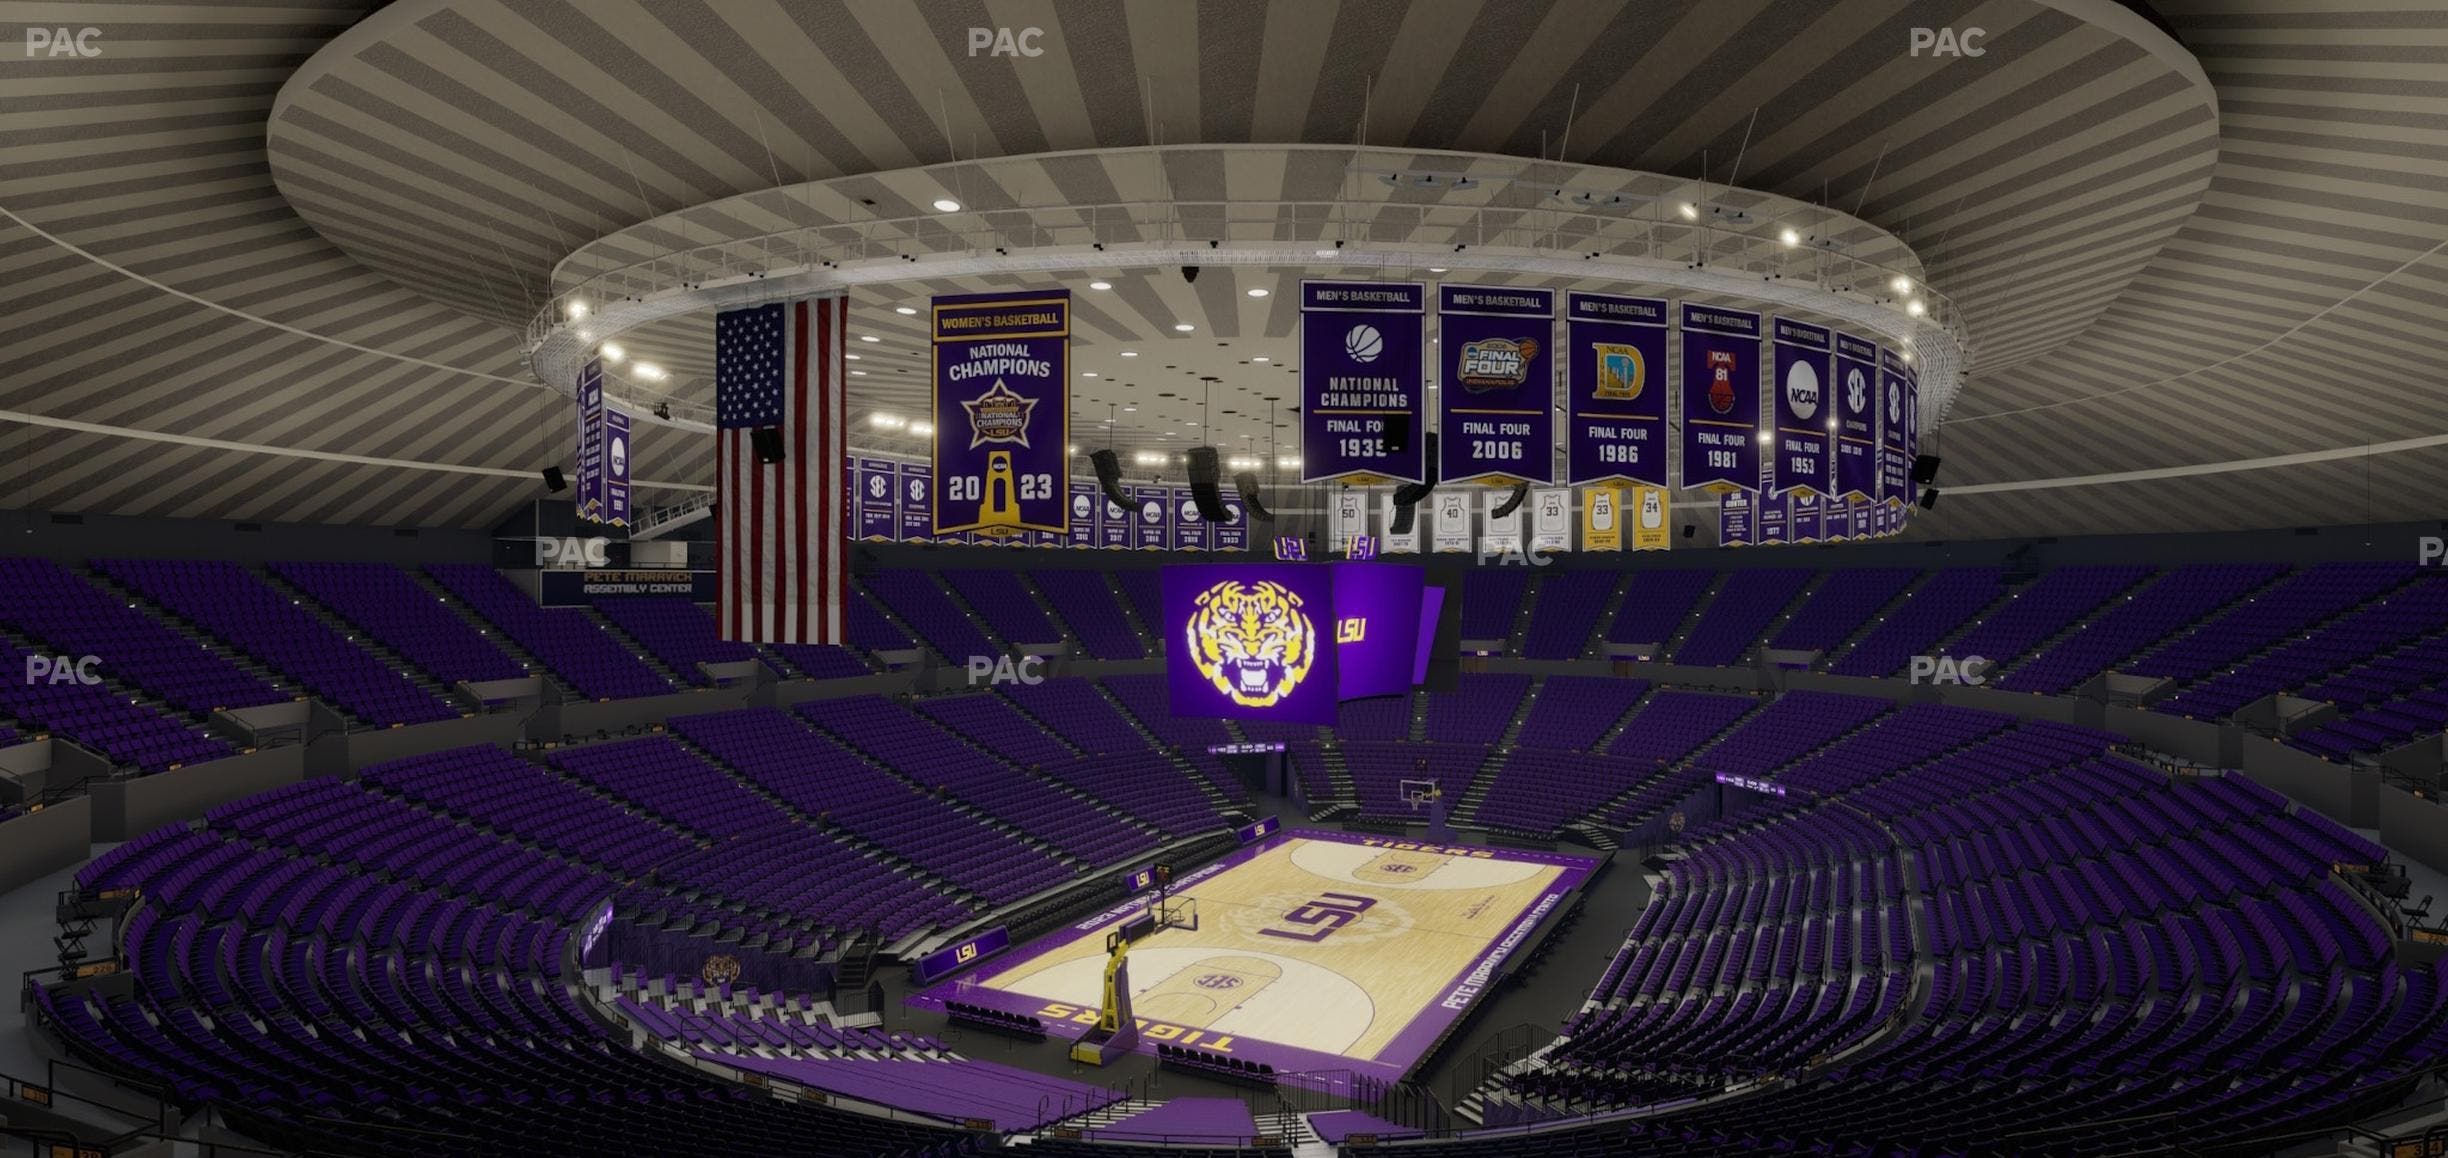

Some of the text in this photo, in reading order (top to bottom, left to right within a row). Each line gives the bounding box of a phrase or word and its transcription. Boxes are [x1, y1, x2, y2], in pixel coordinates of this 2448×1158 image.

[1317, 290, 1410, 303] MEN'S BASKETBALL
[1453, 294, 1541, 308] MEN'S BASKETBALL
[1579, 301, 1657, 317] MEN'S BASKETBALL
[942, 313, 1058, 329] WOMEN'S BASKETBALL
[1714, 313, 1752, 329] BASKETBALL
[970, 344, 1030, 359] NATIONAL
[1480, 350, 1519, 360] FINAL
[1712, 351, 1731, 362] NCAA
[949, 359, 1051, 381] CHAMPIONS
[1465, 360, 1519, 375] FOUR
[1715, 368, 1728, 381] 81
[1329, 377, 1399, 392] NATIONAL
[1321, 393, 1408, 408] CHAMPIONS
[1791, 388, 1818, 404] NCAA
[976, 418, 1023, 428] CHAMPIONS
[1327, 420, 1361, 433] FINAL
[1463, 422, 1530, 436] FINAL FOUR
[1589, 426, 1647, 440] FINAL FOUR
[1698, 432, 1745, 446] FINAL FOUR
[1339, 439, 1387, 457] 1935
[1472, 440, 1522, 459] 2006
[1599, 444, 1639, 463] 1986
[1785, 439, 1820, 454] FINAL FOUR
[1708, 450, 1736, 468] 1981
[1791, 457, 1815, 474] 1953
[950, 473, 1052, 500] 20 23
[1342, 509, 1355, 518] 50
[1447, 509, 1458, 518] 40
[1546, 506, 1559, 517] 33
[1596, 505, 1609, 515] 33
[1645, 502, 1658, 513] 34
[584, 572, 692, 582] PETE MARAVICH
[584, 584, 692, 593] ASSEMBLY CENTER
[1337, 618, 1367, 644] LSU
[1363, 839, 1495, 859] TIGERS
[1136, 870, 1150, 887] LSU
[1257, 892, 1378, 943] LSU
[956, 942, 977, 964] LSU
[1441, 985, 1479, 1010] PETE
[1036, 1002, 1235, 1053] TIGRS
